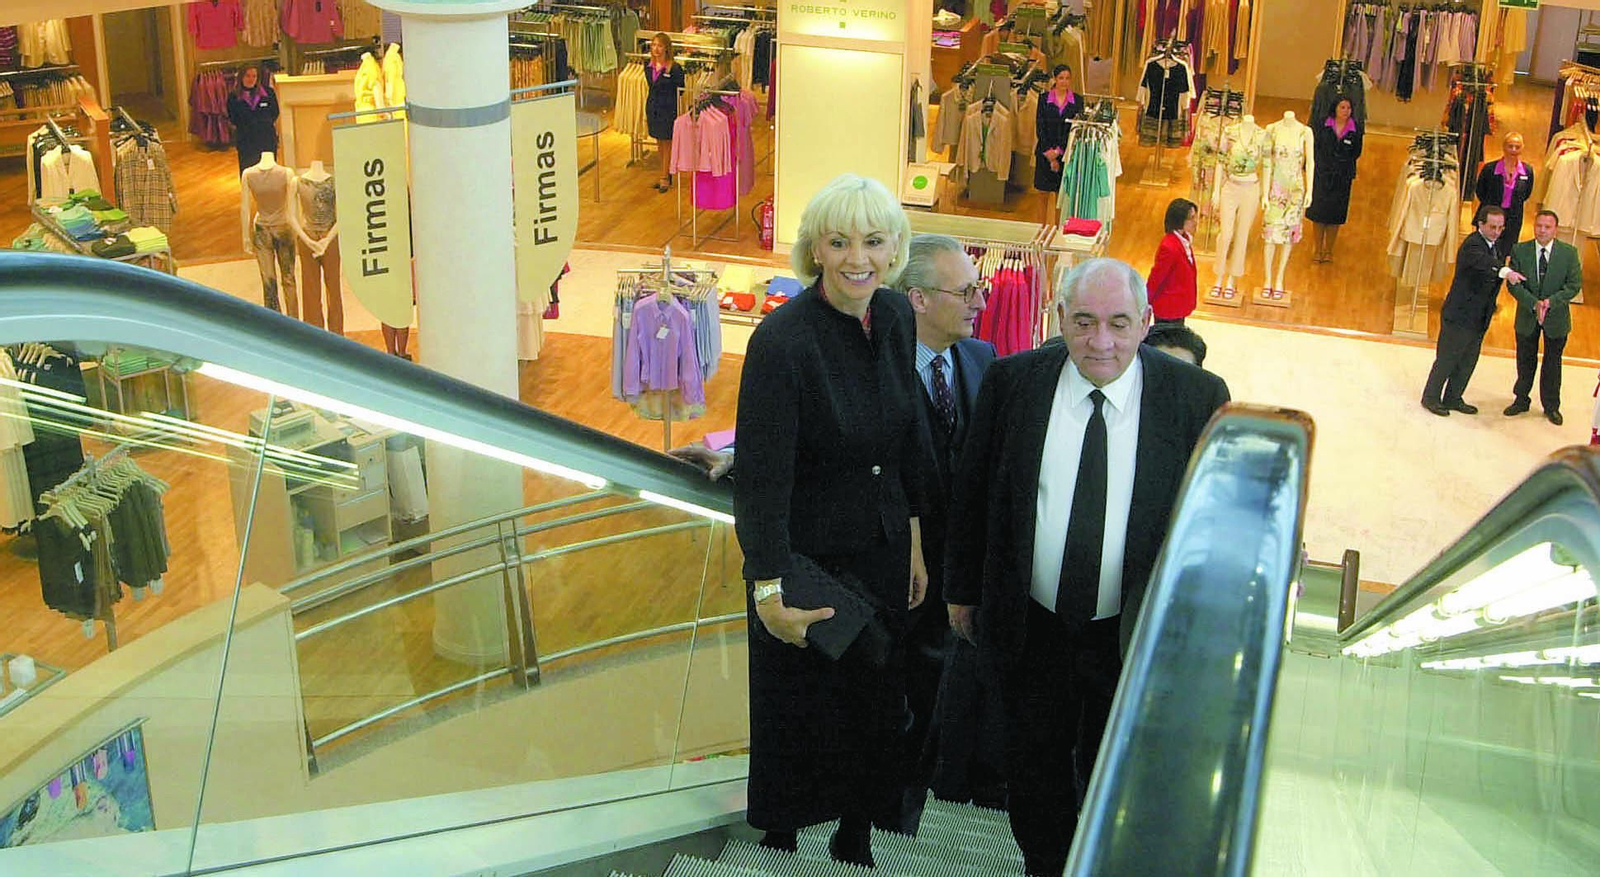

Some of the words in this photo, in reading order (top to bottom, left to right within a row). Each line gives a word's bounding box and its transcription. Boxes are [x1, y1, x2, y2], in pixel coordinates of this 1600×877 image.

[791, 5, 847, 16] ROBERTO
[853, 10, 896, 20] VERINO
[362, 158, 389, 277] Firmas
[534, 131, 558, 246] Firmas
